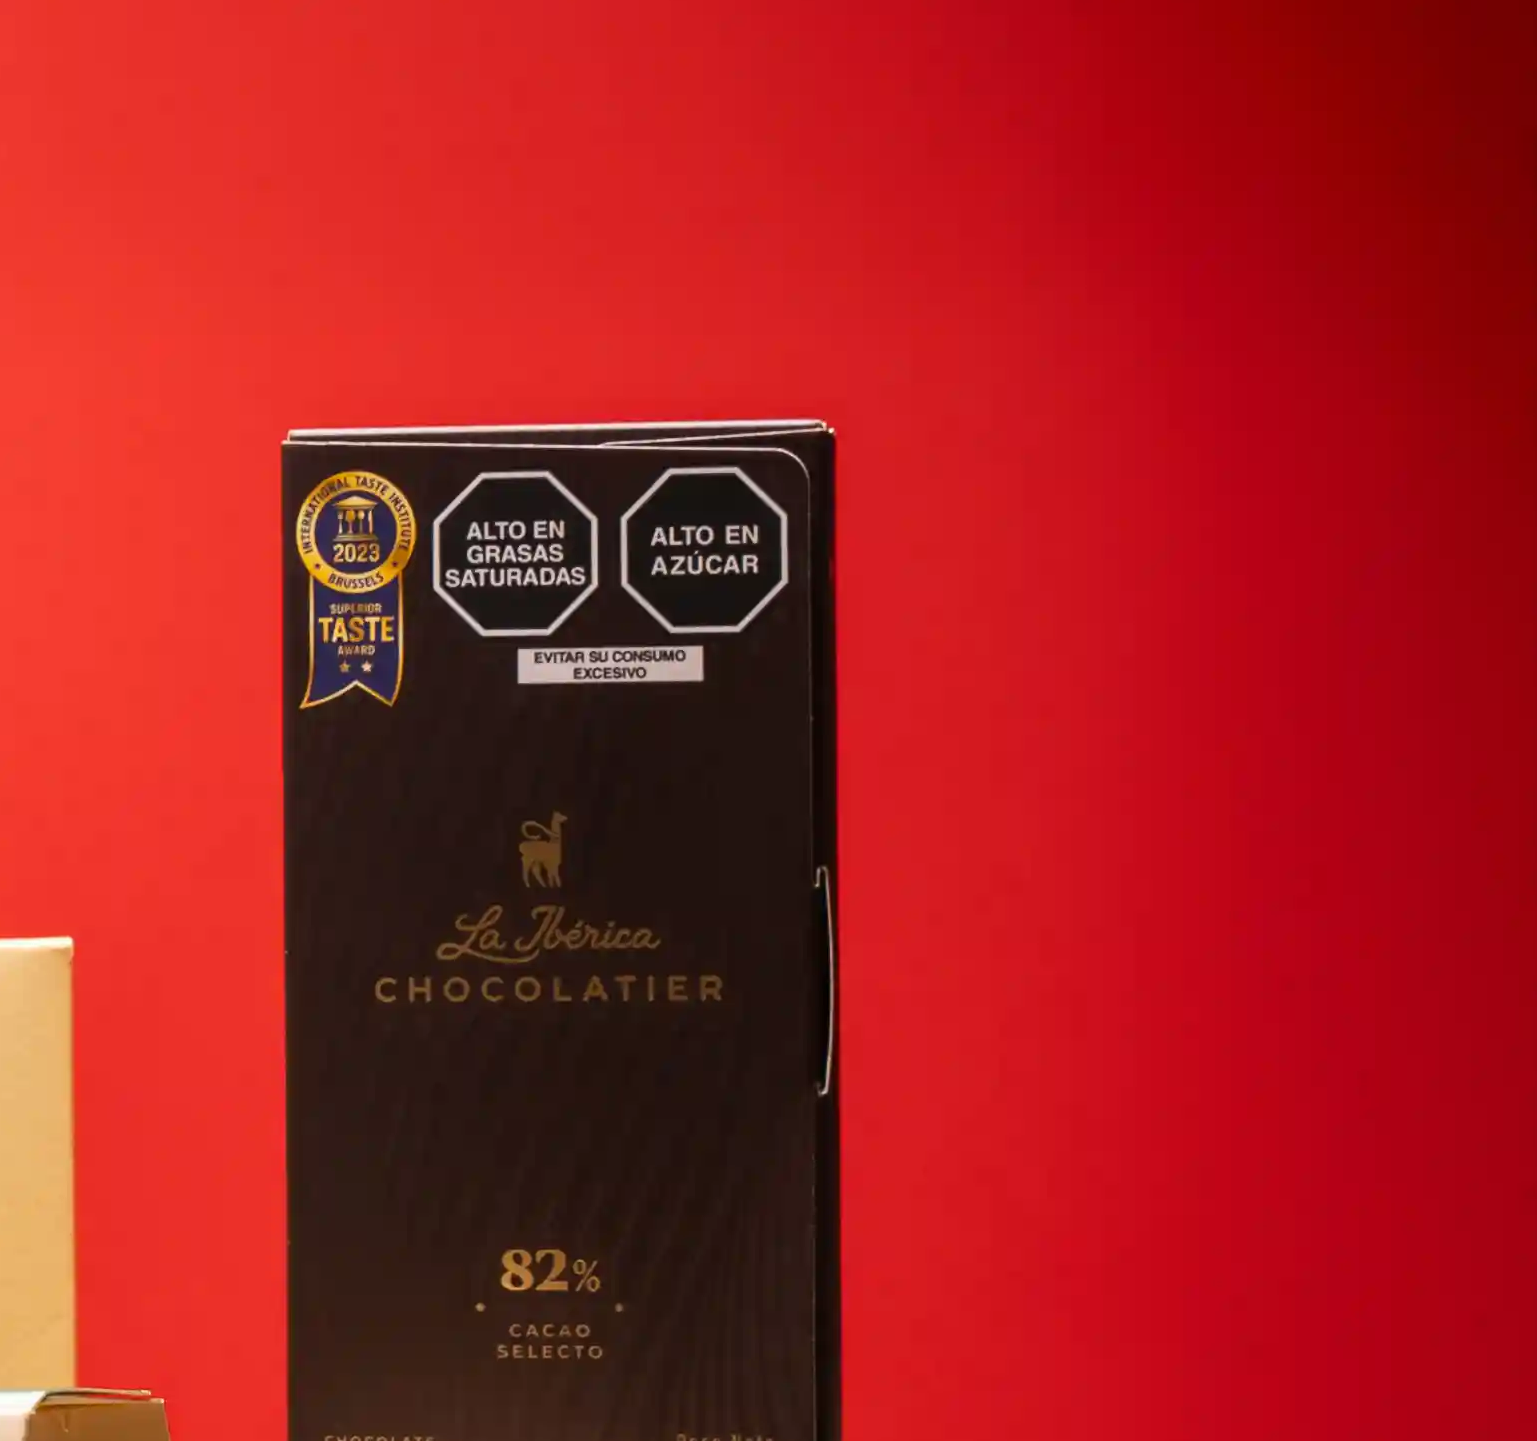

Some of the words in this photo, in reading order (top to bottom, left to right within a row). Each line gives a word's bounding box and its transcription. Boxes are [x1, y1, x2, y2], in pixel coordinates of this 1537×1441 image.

[300, 476, 351, 554] INTERNATIONAL
[355, 476, 389, 497] TASTE
[389, 492, 412, 551] INSTITUTE
[467, 520, 526, 541] ALTO
[533, 520, 565, 540] EN
[651, 525, 715, 547] ALTO
[726, 524, 759, 545] EN
[333, 543, 380, 563] 2023
[467, 543, 564, 564] GRASAS
[651, 551, 759, 576] AZÚCAR
[328, 572, 384, 589] BRUSSELS
[445, 566, 586, 588] SATURADAS
[329, 603, 382, 615] SUPERIOR
[318, 616, 394, 643] TASTE
[338, 645, 375, 656] AWARD
[534, 651, 585, 664] EVITAR
[589, 650, 609, 664] SU
[612, 649, 686, 663] CONSUMO
[573, 666, 646, 680] EXCESIVO
[436, 905, 539, 964] La
[515, 905, 661, 952] Ibérica
[374, 974, 723, 1003] CHOCOLATIER
[500, 1249, 601, 1292] 82%
[508, 1324, 591, 1338] CACAO
[497, 1344, 604, 1359] SELECTO
